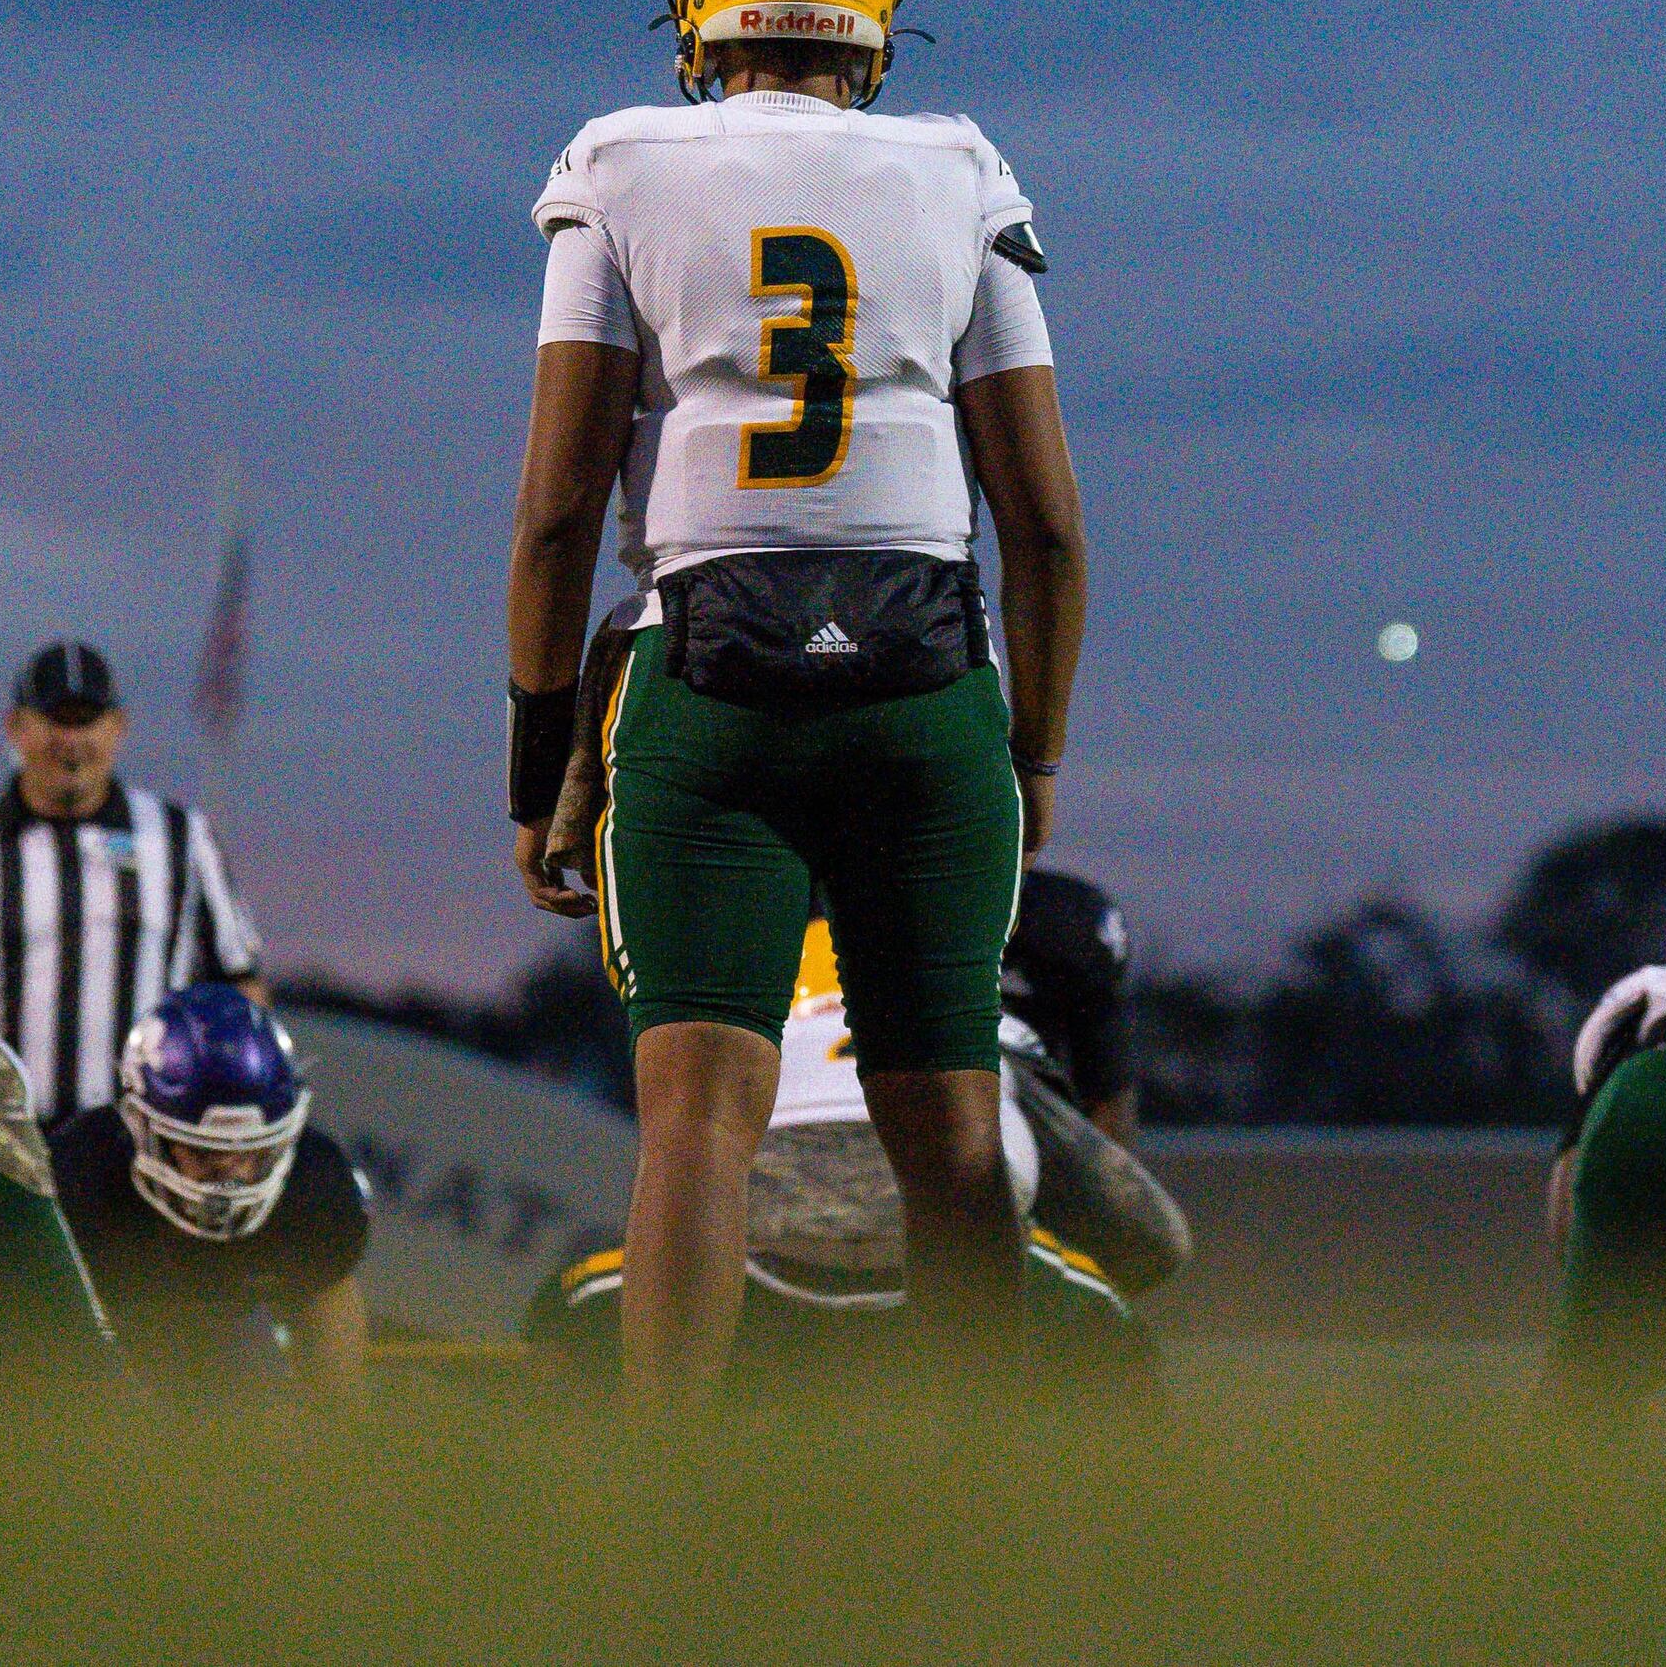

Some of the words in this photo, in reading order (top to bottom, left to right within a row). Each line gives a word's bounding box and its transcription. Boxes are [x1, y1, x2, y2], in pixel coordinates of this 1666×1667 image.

[740, 10, 855, 36] Riddell
[736, 225, 858, 489] 3
[805, 641, 858, 653] adidas
